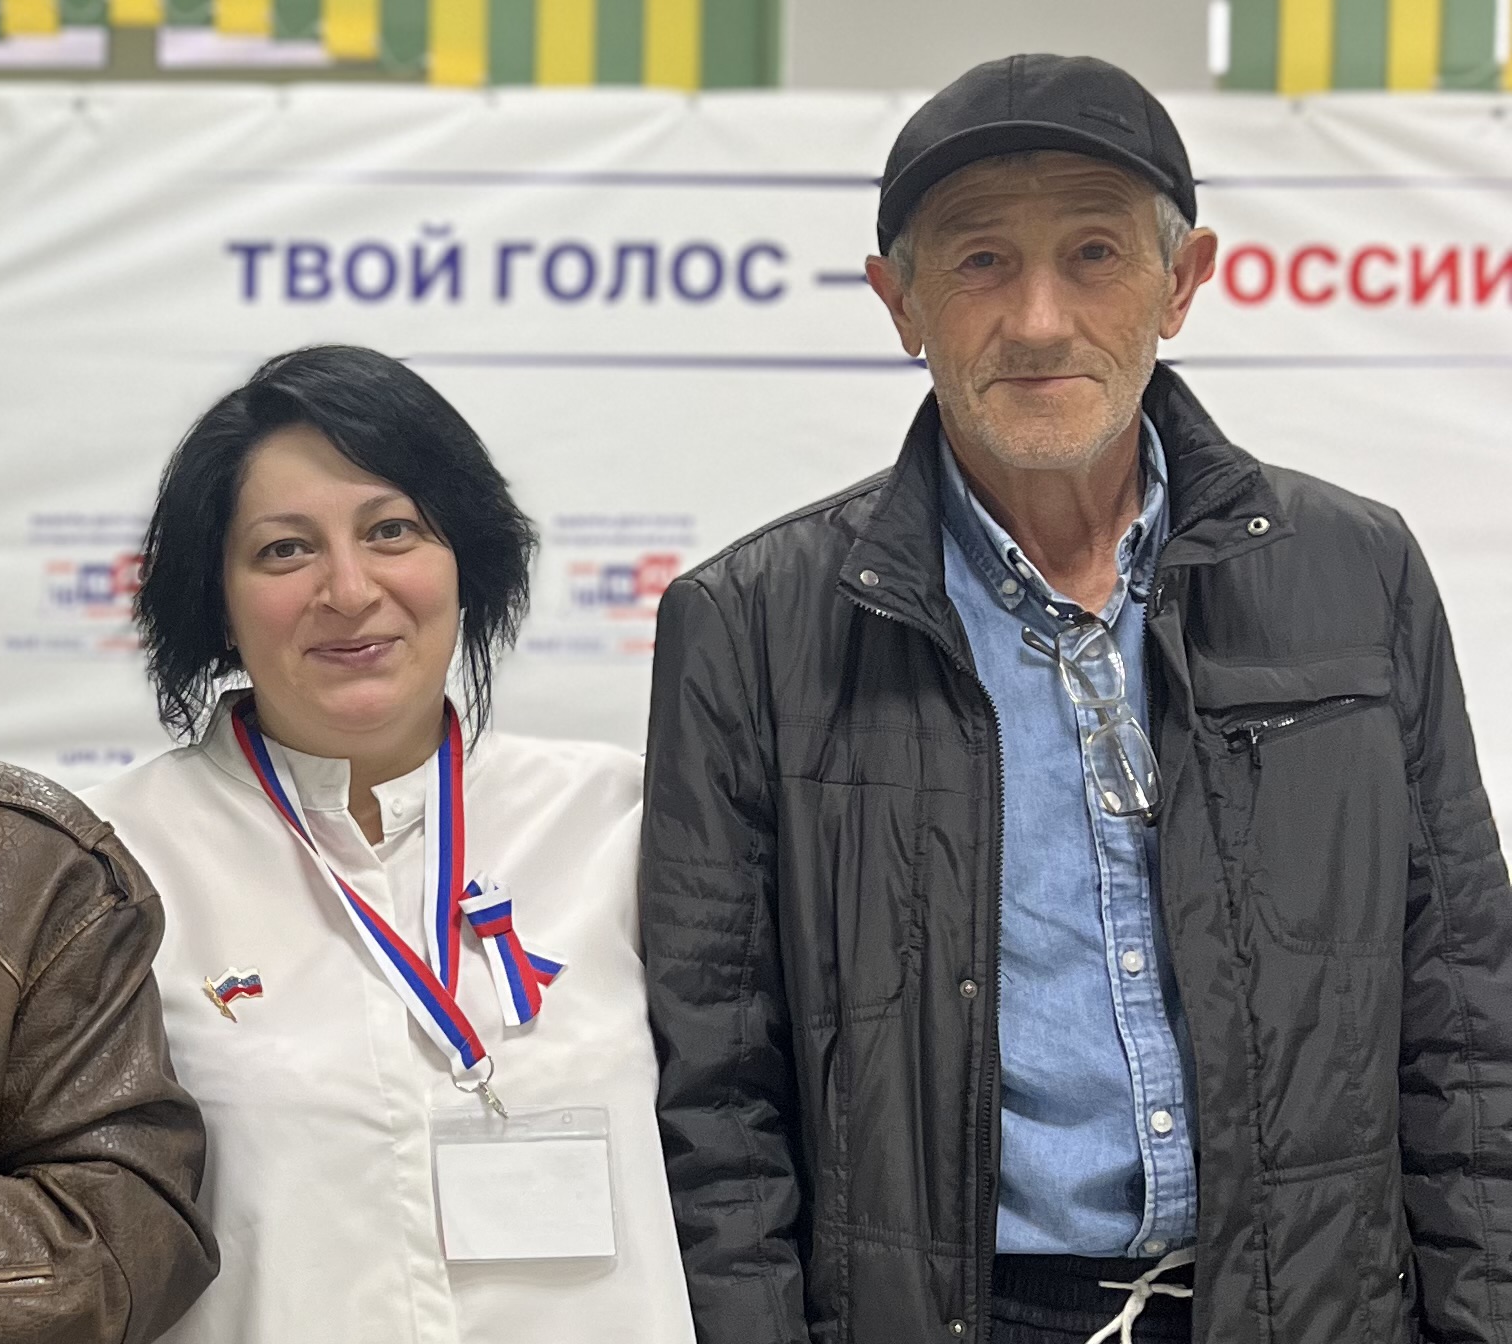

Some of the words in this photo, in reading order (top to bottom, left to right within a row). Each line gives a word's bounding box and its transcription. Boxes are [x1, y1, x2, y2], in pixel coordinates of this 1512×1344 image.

[225, 224, 465, 304] ТВОЙ
[492, 239, 789, 306] ГОЛОС
[1221, 242, 1512, 308] ОССИИ
